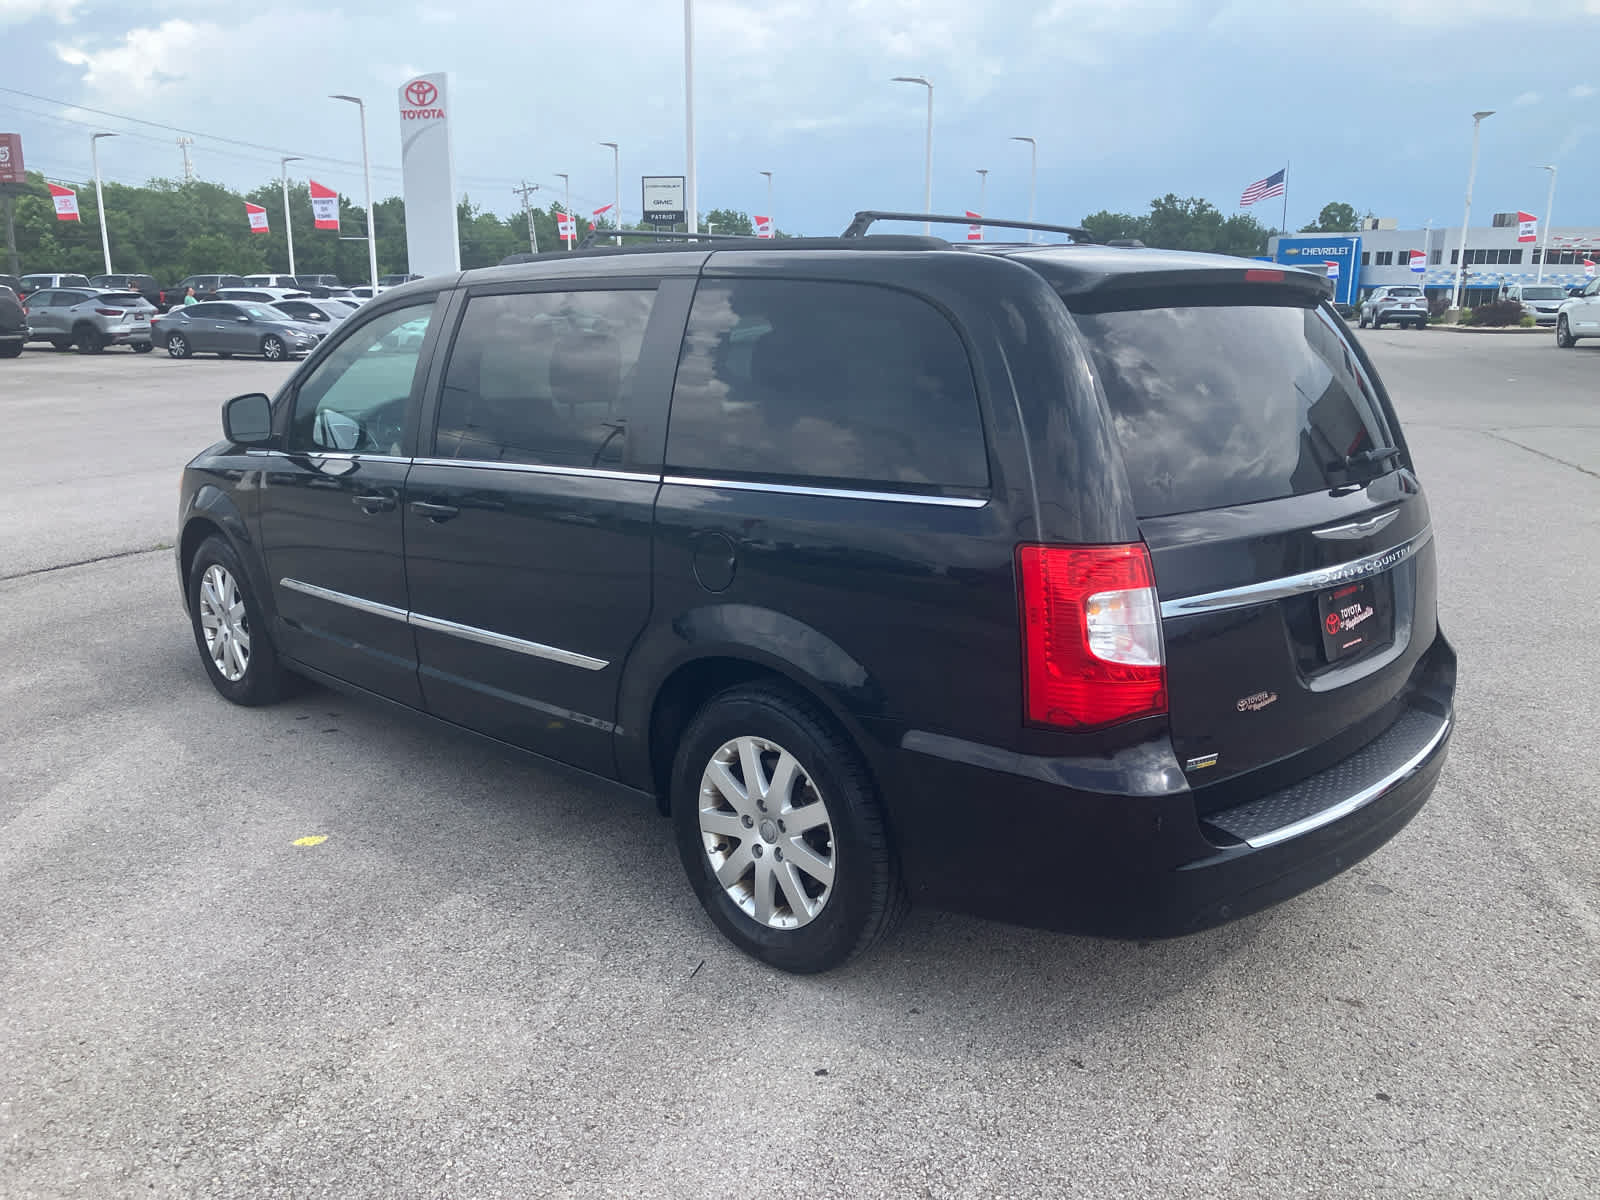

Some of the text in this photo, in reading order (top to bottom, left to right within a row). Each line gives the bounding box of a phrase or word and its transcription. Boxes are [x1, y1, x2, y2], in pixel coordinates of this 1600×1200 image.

[401, 108, 445, 120] TOYOTA
[1301, 247, 1349, 256] CHEVROLET
[1340, 603, 1362, 619] TOYOTA
